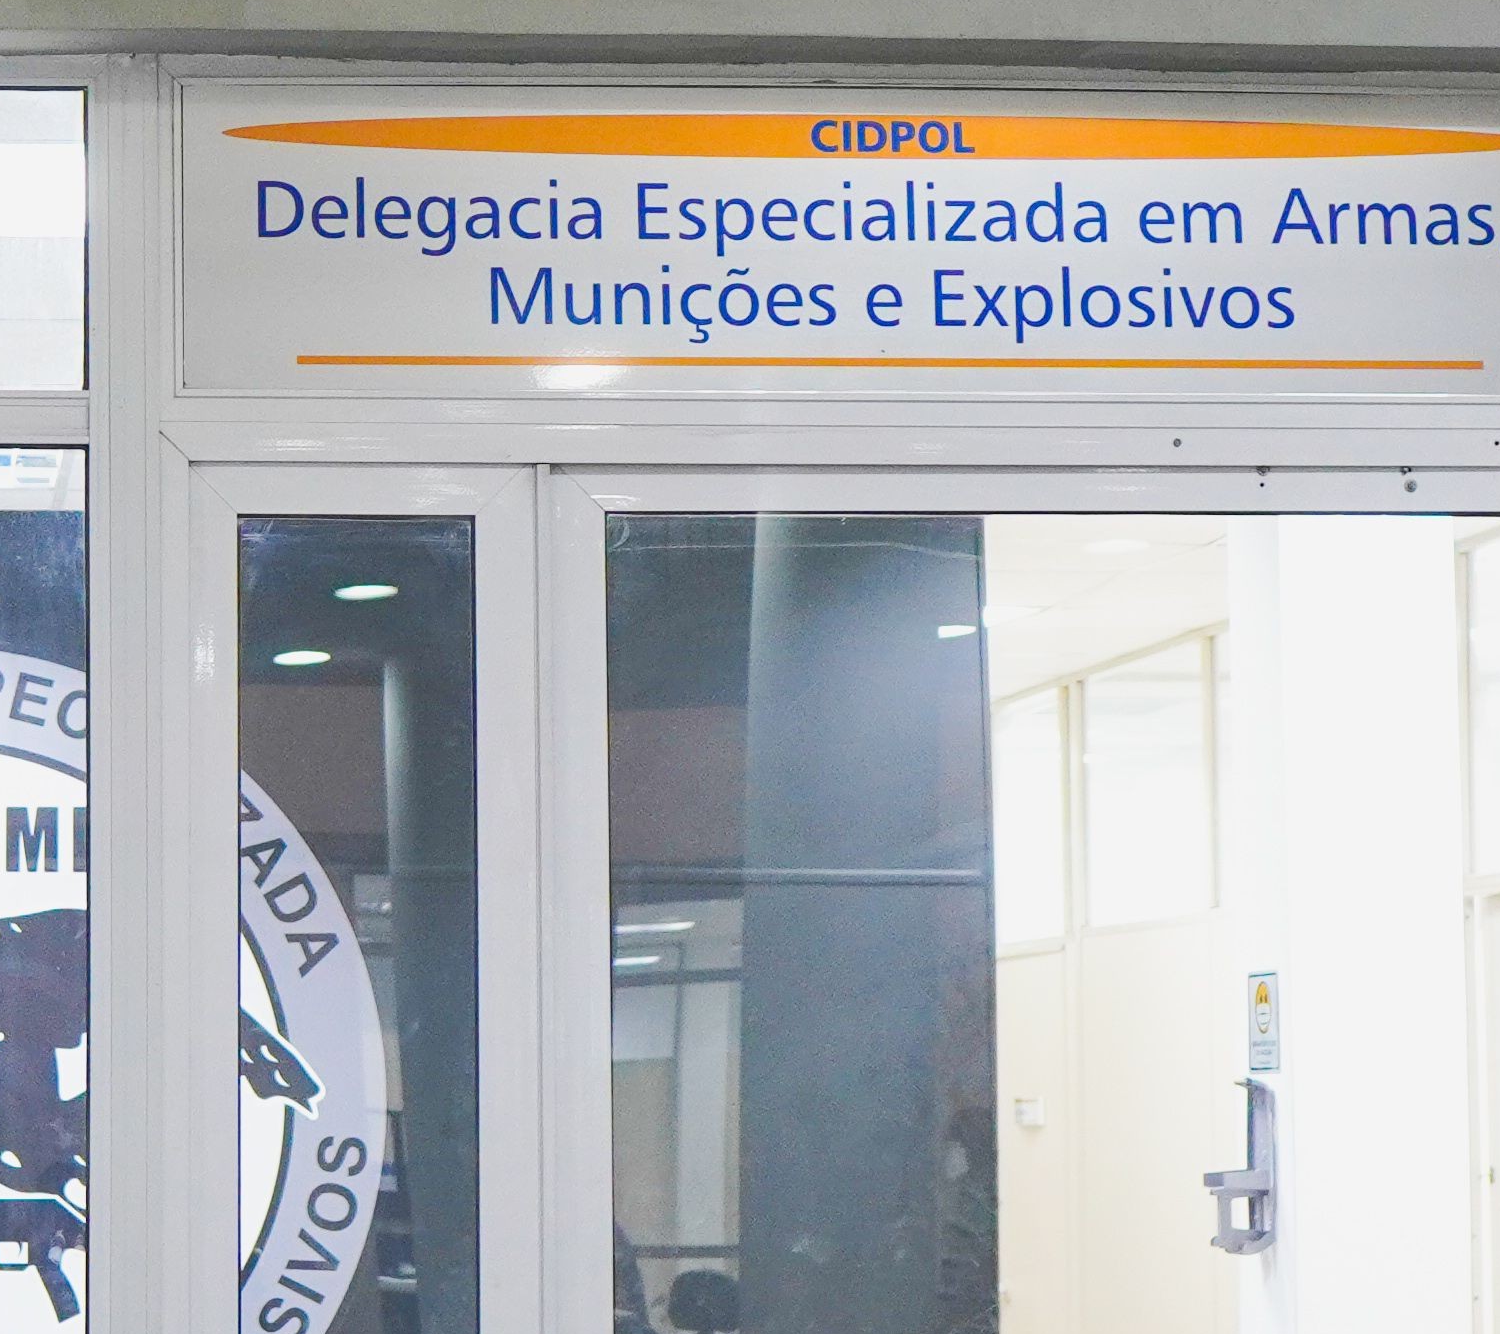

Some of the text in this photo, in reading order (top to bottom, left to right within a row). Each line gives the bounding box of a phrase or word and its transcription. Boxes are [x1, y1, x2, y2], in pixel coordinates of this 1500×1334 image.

[810, 119, 976, 154] CIDPOL
[257, 177, 603, 258] Delegacia
[636, 178, 1109, 258] Especializada
[1138, 200, 1244, 245] em
[489, 265, 1296, 346] Munições e Explosivos
